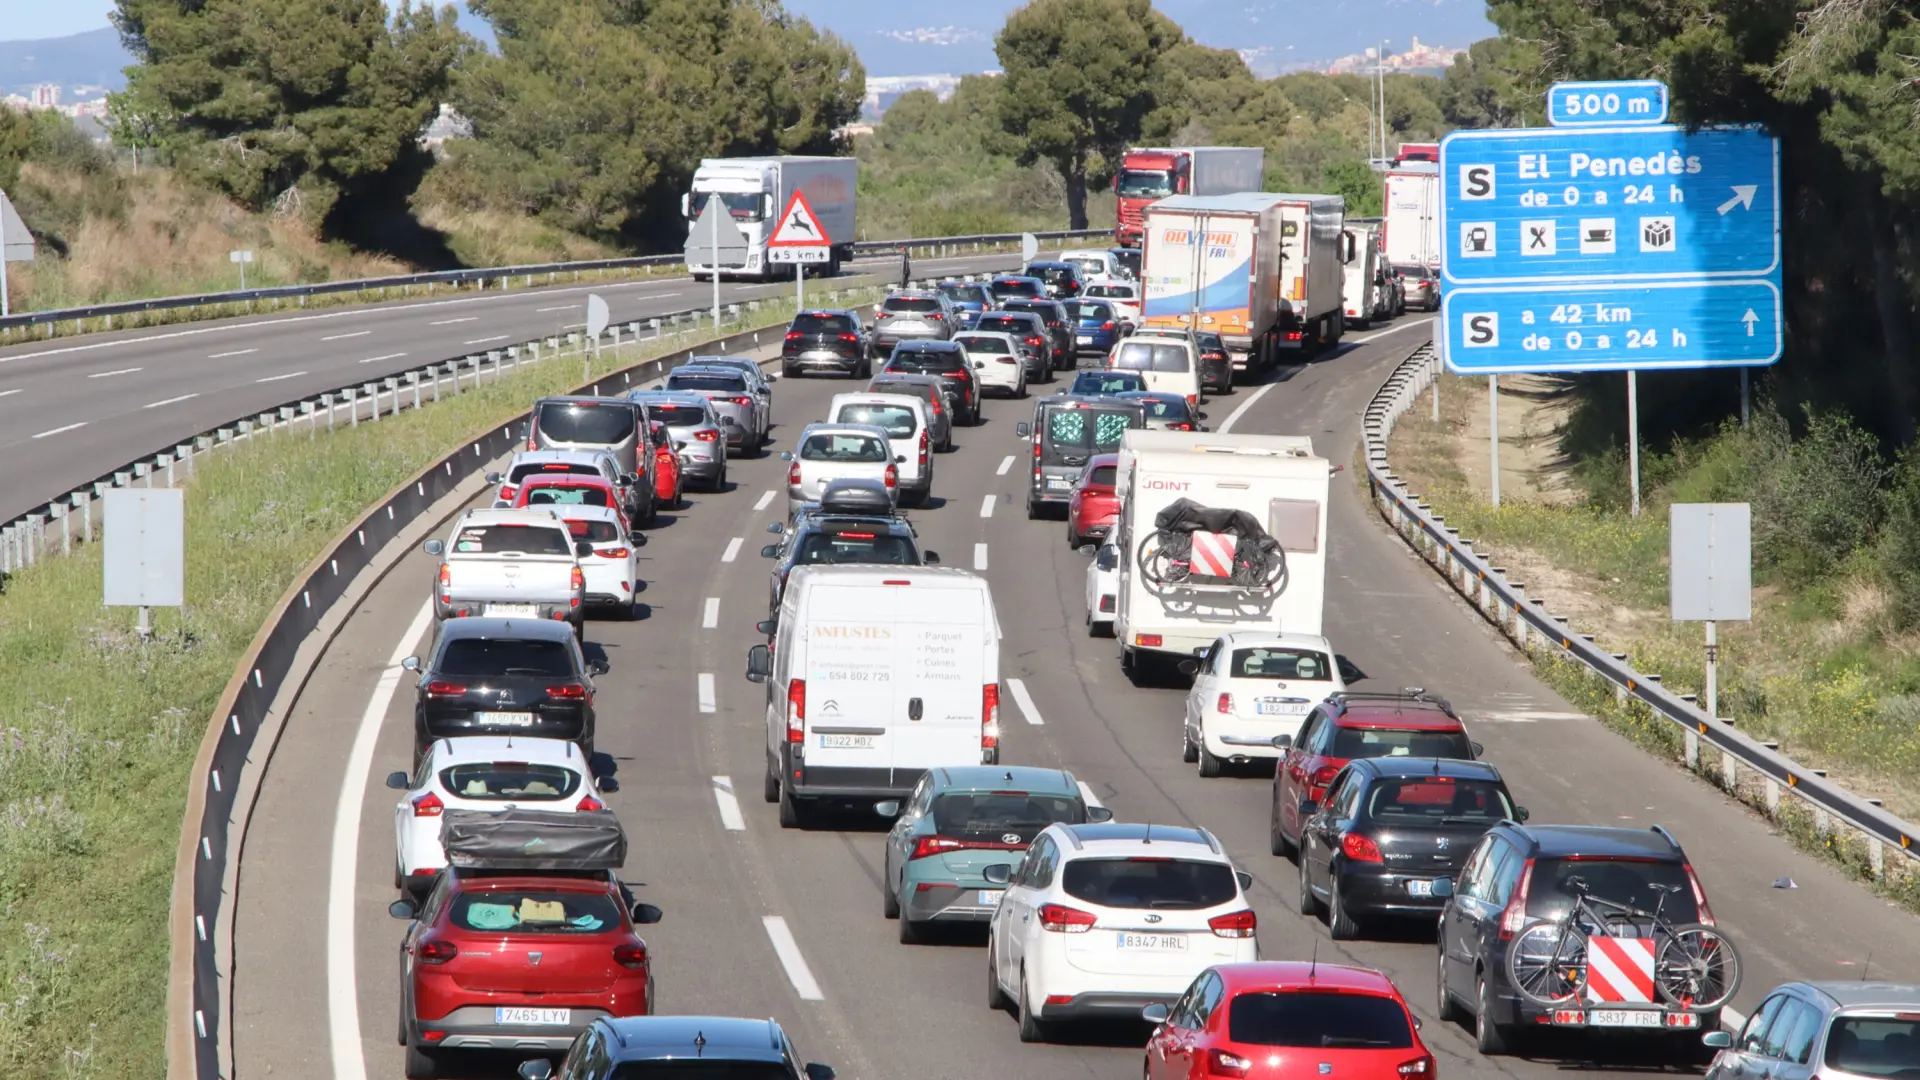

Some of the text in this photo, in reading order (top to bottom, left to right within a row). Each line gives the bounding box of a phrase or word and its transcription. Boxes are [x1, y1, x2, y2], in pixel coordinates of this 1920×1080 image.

[1566, 95, 1650, 115] 500 m
[1518, 150, 1702, 179] El Penedès
[1466, 168, 1491, 197] S
[1520, 184, 1684, 206] de 0 a 24 h
[783, 249, 816, 260] 5 km
[1522, 303, 1631, 325] a 42 km
[1469, 316, 1494, 344] S
[1522, 328, 1687, 351] de 0 a 24 h
[1142, 480, 1191, 491] JOINT
[812, 626, 891, 640] ANFUSTES
[925, 631, 962, 642] Parquet
[925, 645, 955, 654] Portes
[924, 658, 956, 667] Cuines
[829, 671, 847, 681] 654
[872, 672, 890, 682] 729
[923, 671, 961, 681] Armaris
[1126, 936, 1184, 949] 8347 HRL
[505, 1009, 568, 1023] 7465 LYV
[1598, 1011, 1657, 1024] 5837 FRC
